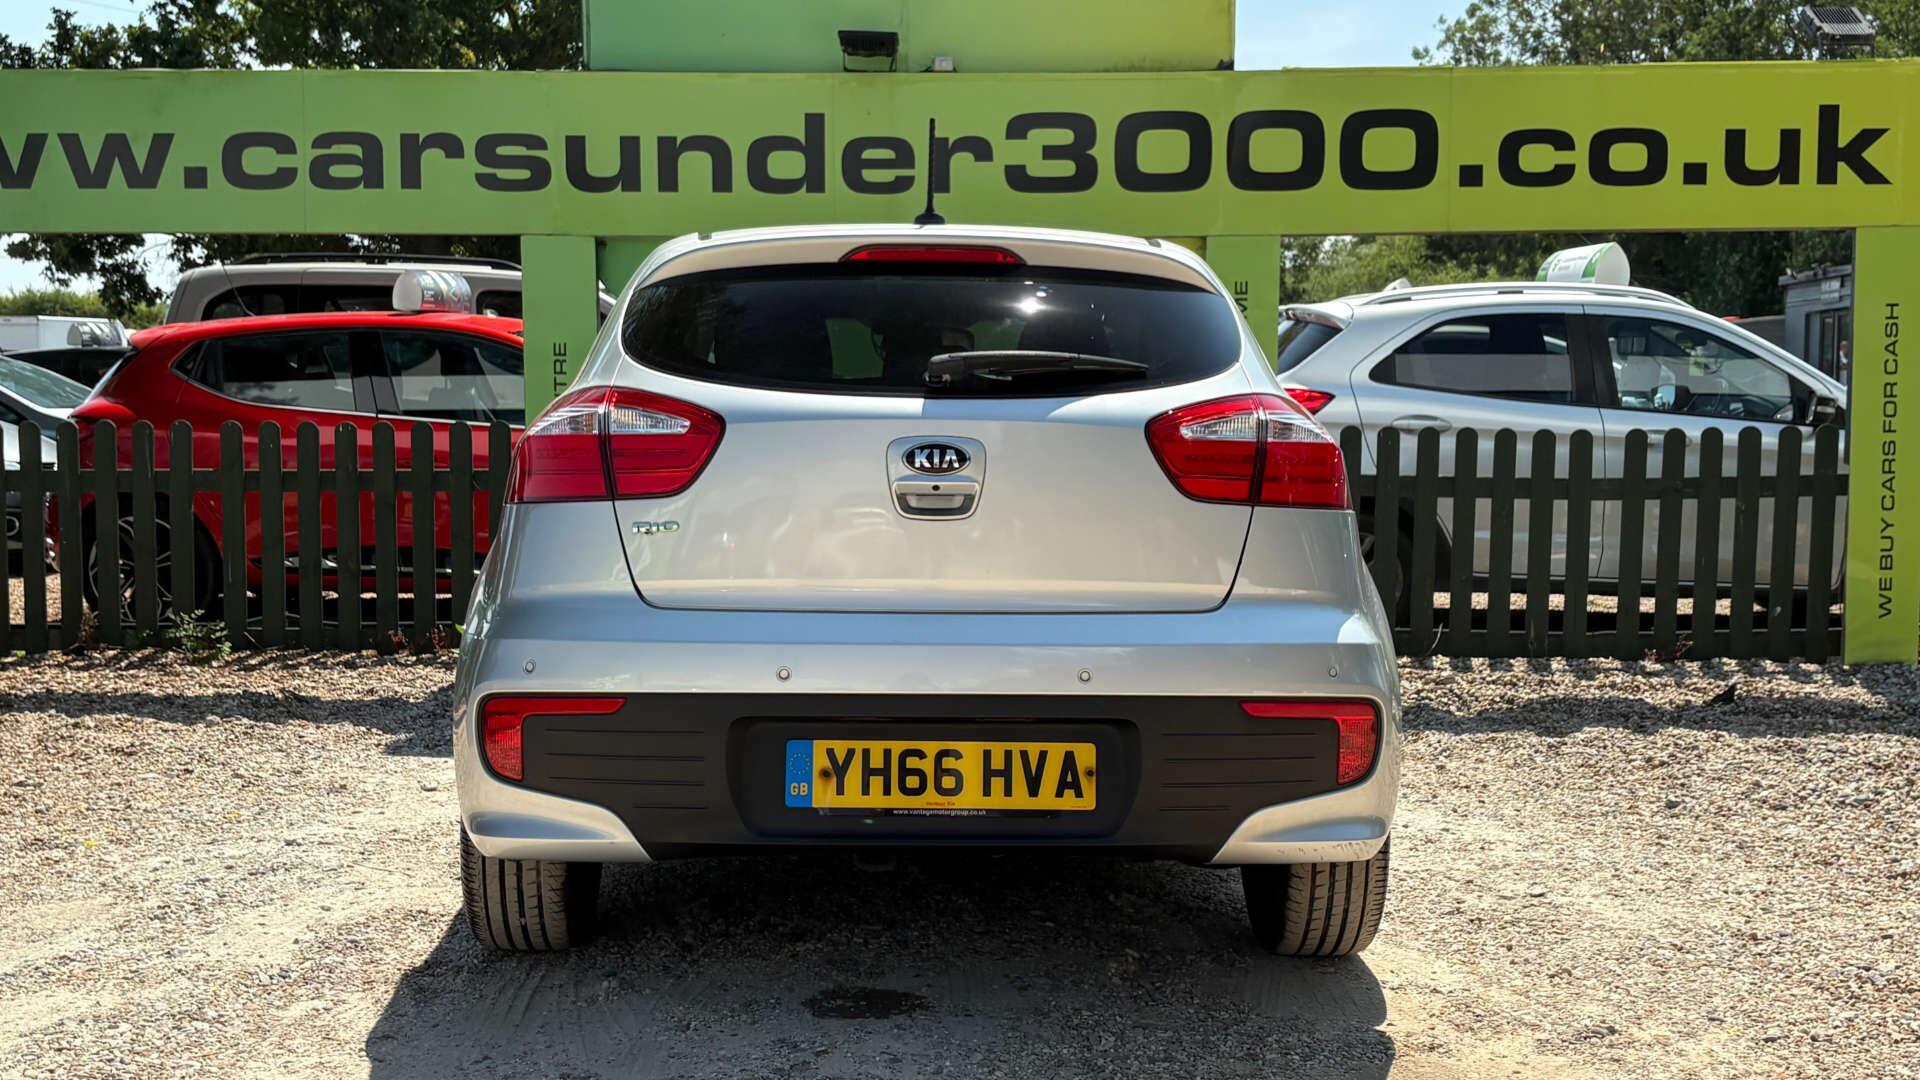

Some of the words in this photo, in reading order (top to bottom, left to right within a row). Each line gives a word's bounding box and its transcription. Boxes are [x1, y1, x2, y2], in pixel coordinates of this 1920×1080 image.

[1884, 303, 1900, 375] CASH
[553, 342, 567, 397] TRE
[1883, 382, 1898, 433] FOR
[914, 448, 960, 468] KIA
[1881, 440, 1897, 512] CARS
[1880, 517, 1895, 571] BUY
[1878, 577, 1893, 619] WE
[790, 782, 809, 796] GB
[825, 747, 965, 797] YH66
[982, 749, 1084, 798] HVA
